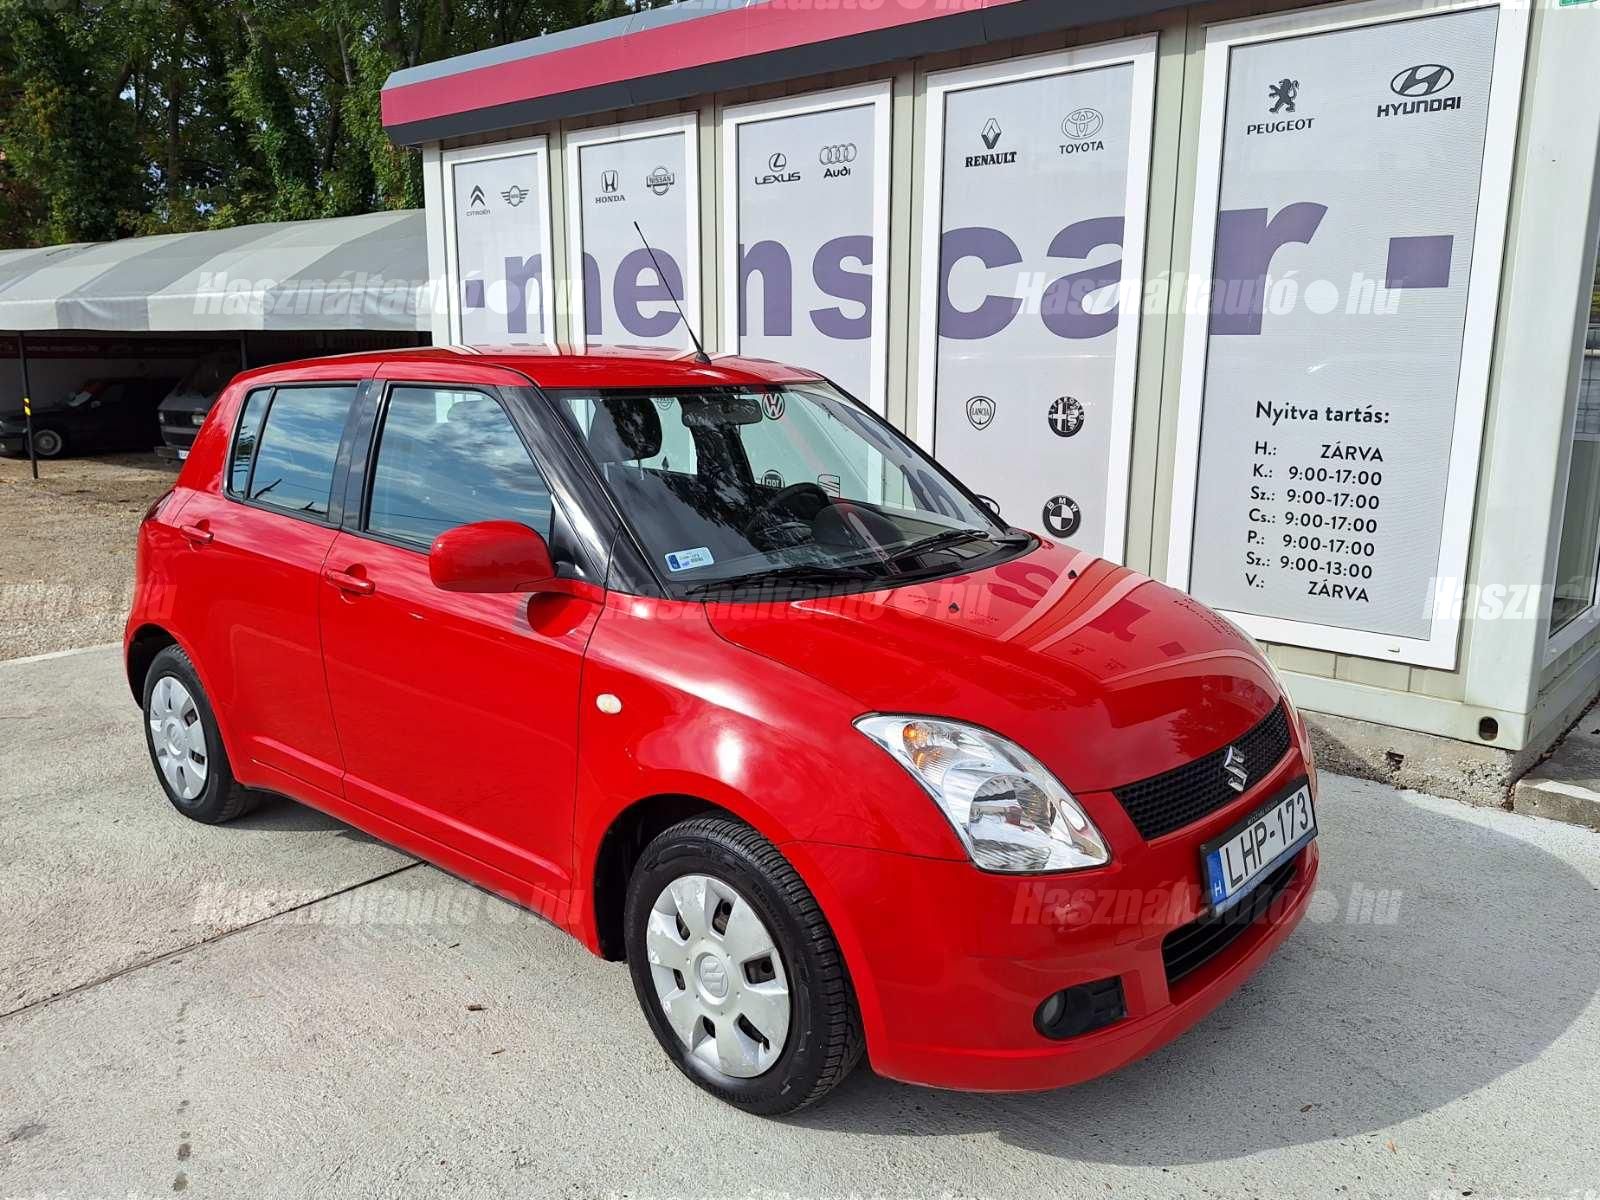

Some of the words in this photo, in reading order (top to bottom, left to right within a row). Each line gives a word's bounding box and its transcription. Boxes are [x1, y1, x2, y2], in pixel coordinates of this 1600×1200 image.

[1377, 96, 1461, 118] HYUNDAI
[1246, 117, 1315, 135] PEUGEOT
[1059, 140, 1104, 155] TOYOTA
[965, 151, 1017, 167] RENAULT
[755, 171, 801, 185] LEXUS
[823, 166, 851, 178] Audi
[595, 194, 626, 204] HONDA
[1256, 400, 1318, 426] Nyitva
[1325, 404, 1390, 424] tartás:
[1254, 440, 1277, 456] H.:
[1320, 441, 1384, 462] ZÁRVA
[1253, 463, 1273, 478] K.:
[1288, 465, 1382, 486] 9:00-17:00
[1046, 497, 1079, 512] BMW
[1250, 485, 1276, 501] Sz.:
[1286, 488, 1380, 510] 9:00-17:00
[1248, 508, 1276, 524] Cs.:
[1284, 511, 1377, 533] 9:00-17:00
[1247, 530, 1265, 545] P.:
[1282, 534, 1375, 557] 9:00-17:00
[1246, 551, 1271, 567] Sz.:
[1280, 555, 1373, 579] 9:00-13:00
[1245, 572, 1265, 588] V.:
[1307, 579, 1370, 602] ZÁRVA
[1225, 791, 1309, 889] LHP-173
[1214, 883, 1223, 897] H
